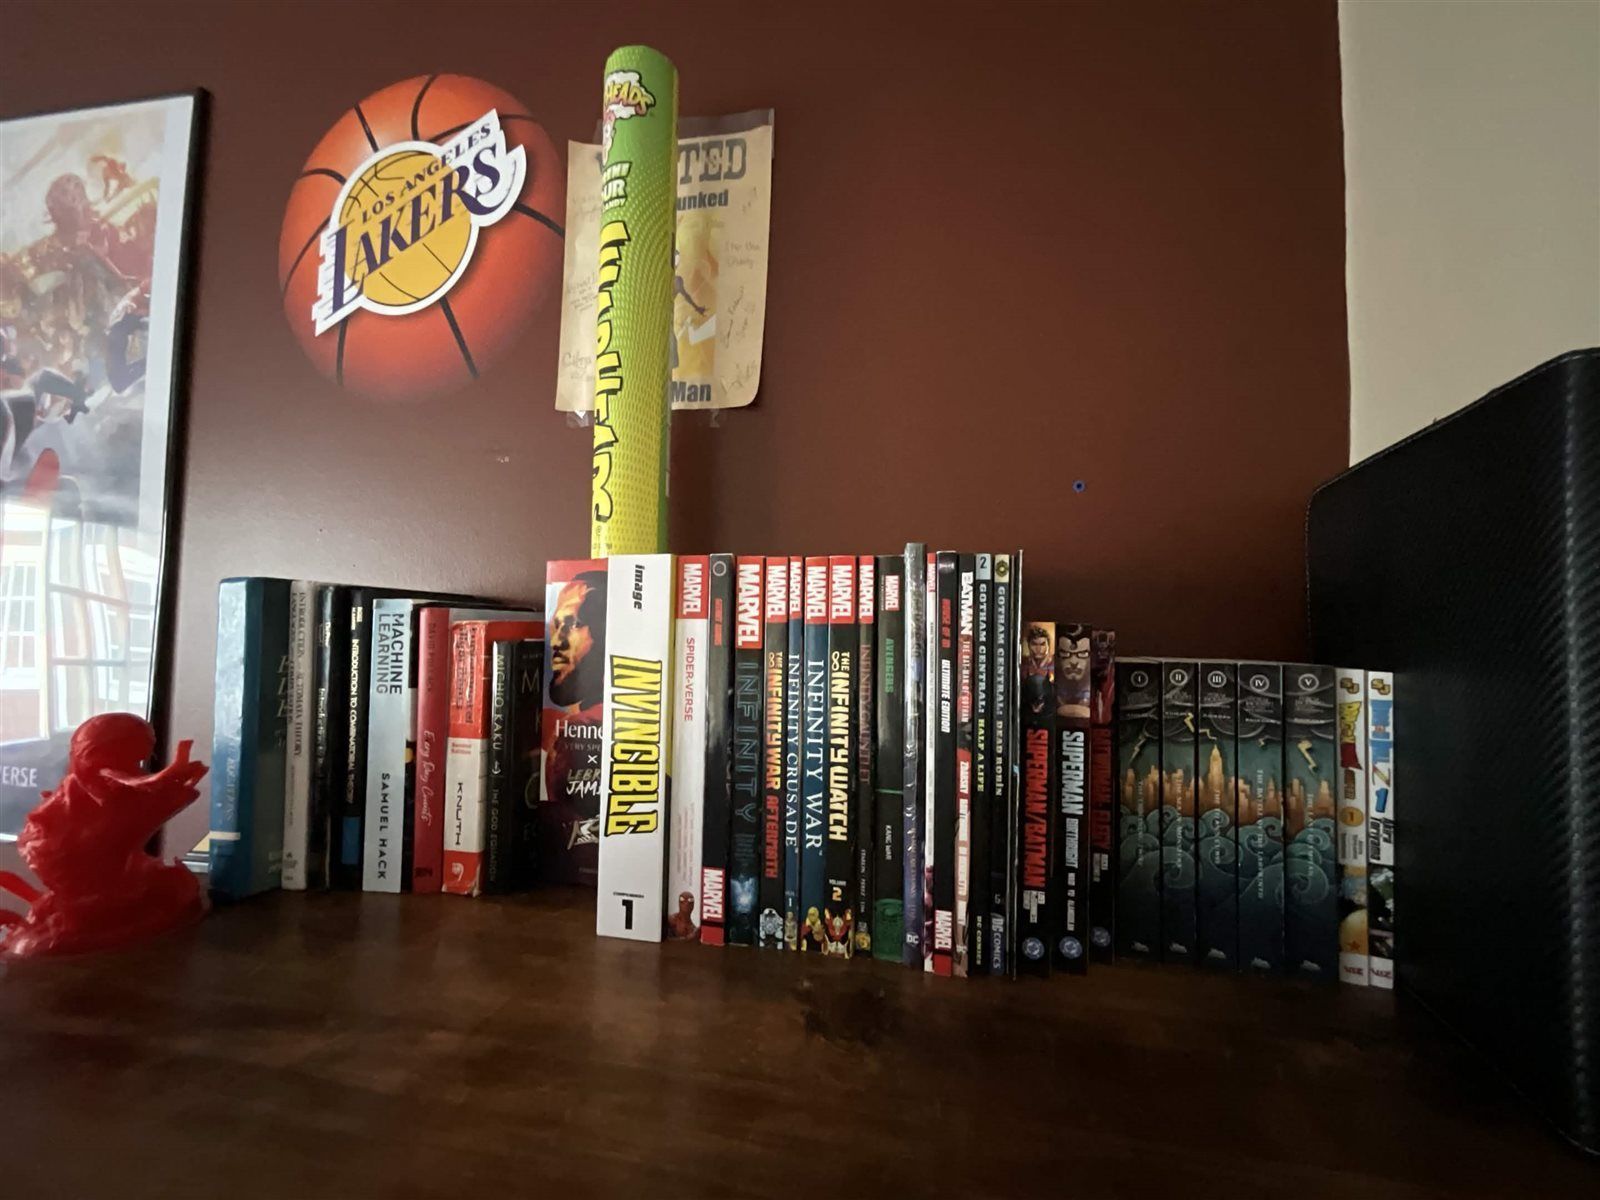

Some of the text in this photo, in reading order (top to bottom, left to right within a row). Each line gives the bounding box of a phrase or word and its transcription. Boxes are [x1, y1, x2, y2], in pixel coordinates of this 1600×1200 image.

[362, 122, 492, 225] LOS ANGELES
[323, 142, 516, 321] LAKERS
[670, 381, 712, 402] Man
[683, 563, 702, 615] MARVEL
[790, 561, 801, 615] MARVEL
[979, 556, 987, 569] 2
[737, 564, 760, 646] MARVEL
[767, 565, 787, 618] MARVEL
[806, 566, 827, 619] MARVEL
[831, 565, 852, 619] MARVEL
[859, 564, 874, 619] MARVEL
[884, 575, 899, 611] MARVEL
[961, 571, 974, 636] BATMAN
[997, 585, 1006, 645] GOTHAM
[351, 638, 361, 695] INTRODUCTION
[377, 613, 392, 694] LEARNING
[390, 613, 405, 695] MACHINE
[685, 637, 695, 721] SPIDER-VERSE
[842, 651, 850, 671] THE
[886, 637, 895, 694] AVENGERS
[997, 648, 1005, 715] CENTRAL:
[1212, 675, 1222, 683] III
[1304, 678, 1313, 686] V
[349, 697, 359, 708] TO
[493, 654, 506, 751] MICHIO KAKU
[767, 667, 783, 746] INFINITY
[941, 658, 951, 734] ULTIMATE EDITION
[976, 583, 988, 792] GOTHAM CENTRAL: HALF A LIFE
[1254, 679, 1265, 687] IV
[604, 654, 662, 837] INVINCIBLE
[736, 661, 761, 823] INFINITY
[786, 654, 800, 847] INFINITY CRUSADE
[806, 659, 825, 849] INFINITY WAR
[830, 672, 850, 841] INFINITY WATCH
[996, 719, 1004, 754] DEAD
[0, 765, 38, 788] ERSE
[767, 747, 782, 790] WAR
[1062, 730, 1085, 815] SUPERMAN
[378, 772, 391, 880] SAMUEL HACK
[456, 782, 464, 846] KNUTH
[1025, 728, 1049, 888] SUPERMAN/BATMAN
[621, 899, 633, 930] 1
[703, 868, 723, 919] MARVEL
[832, 886, 843, 901] 2
[906, 931, 920, 946] DC
[934, 910, 953, 949] MARVEL
[993, 933, 1002, 969] COMICS
